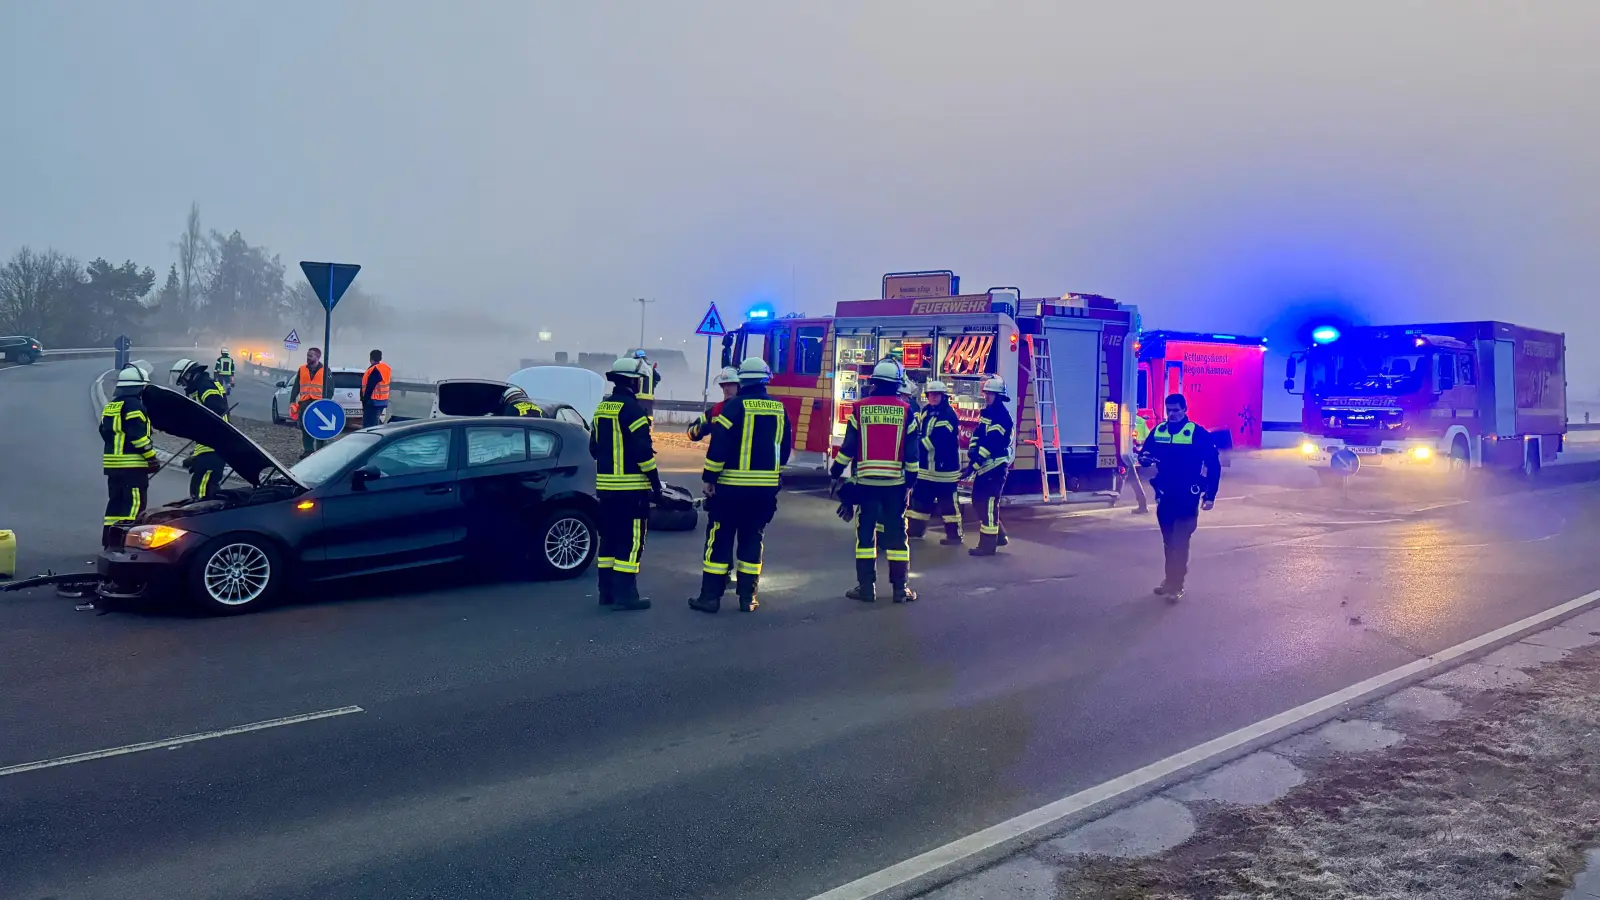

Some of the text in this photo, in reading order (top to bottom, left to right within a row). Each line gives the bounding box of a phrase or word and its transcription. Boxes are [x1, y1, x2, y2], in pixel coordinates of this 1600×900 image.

[910, 300, 988, 315] FEUERWEHR
[1109, 335, 1122, 346] 112
[1184, 352, 1228, 364] Rettungsdienst
[1183, 365, 1233, 376] Region Hannover
[1191, 384, 1202, 393] 112
[743, 400, 783, 410] FEUERWEHR
[861, 406, 904, 415] FEUERWEHR
